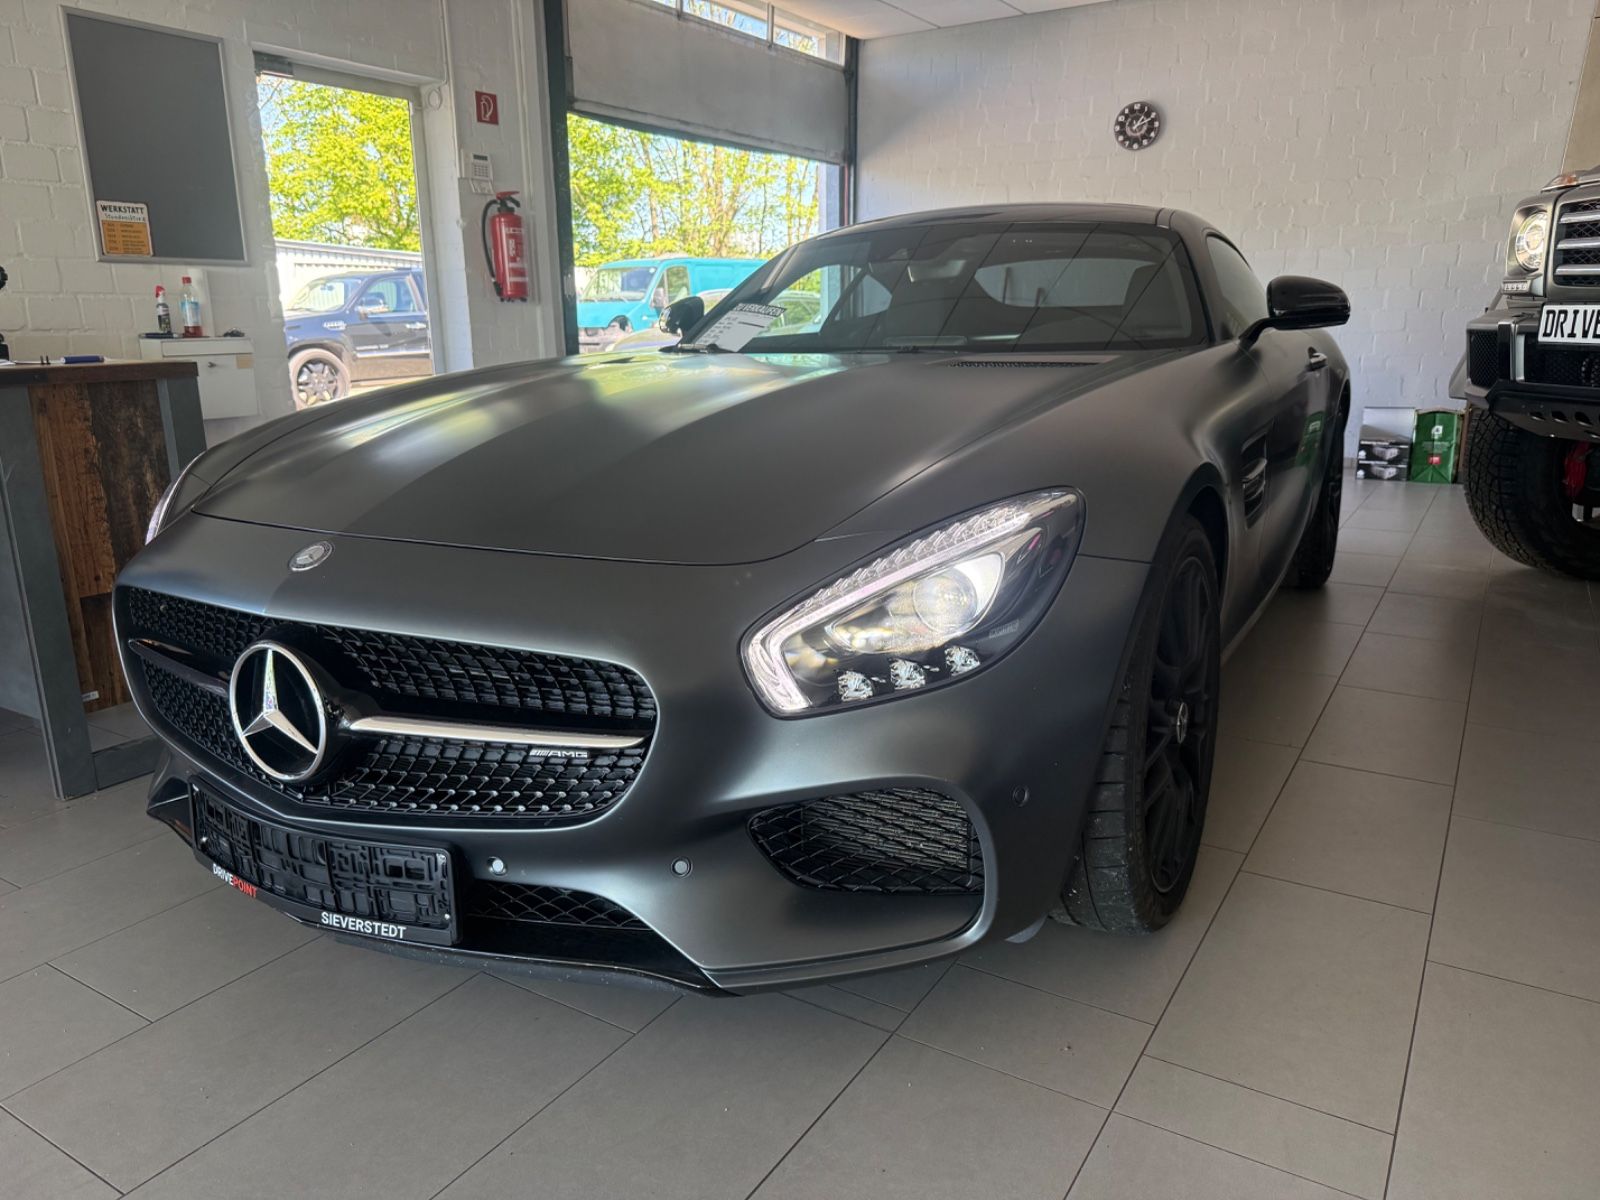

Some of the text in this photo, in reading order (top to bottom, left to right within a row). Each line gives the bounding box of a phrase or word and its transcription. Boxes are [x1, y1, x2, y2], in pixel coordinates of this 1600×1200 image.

[100, 204, 145, 214] WERKSTATT
[547, 750, 588, 758] AMG
[212, 862, 257, 898] DRIVEPOINT
[321, 911, 407, 939] SIEVERSTEDT
